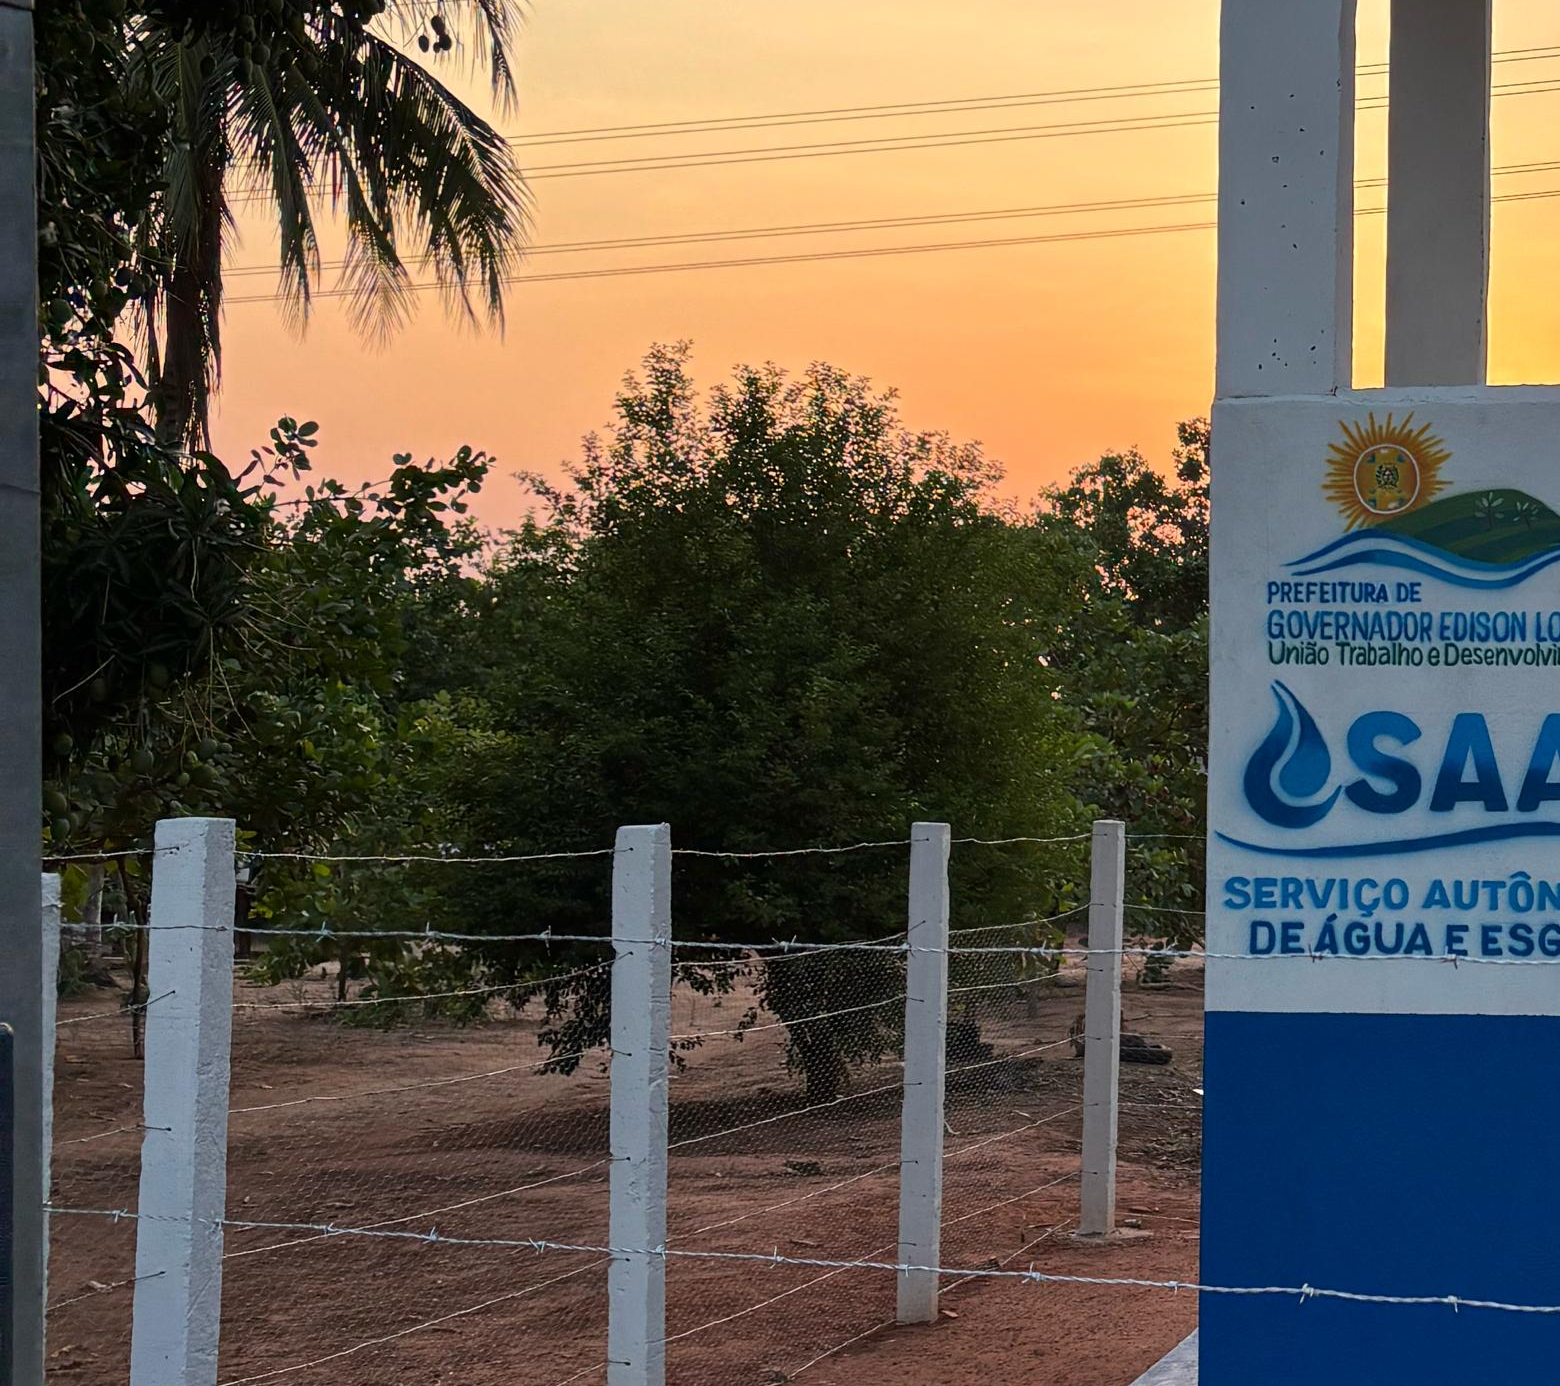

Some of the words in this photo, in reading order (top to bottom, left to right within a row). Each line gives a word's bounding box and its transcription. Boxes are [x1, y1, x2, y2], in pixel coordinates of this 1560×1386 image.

[1267, 581, 1389, 604] PREFEITURA
[1396, 582, 1421, 603] DE
[1267, 610, 1432, 642] GOVERNADOR
[1439, 611, 1526, 642] EDISON
[1268, 642, 1329, 666] União
[1336, 642, 1424, 667] Trabalho
[1427, 646, 1440, 667] e
[1224, 876, 1409, 915] SERVIÇO
[1249, 921, 1305, 955] DE
[1315, 914, 1439, 957] ÁGUA
[1446, 924, 1469, 957] E
